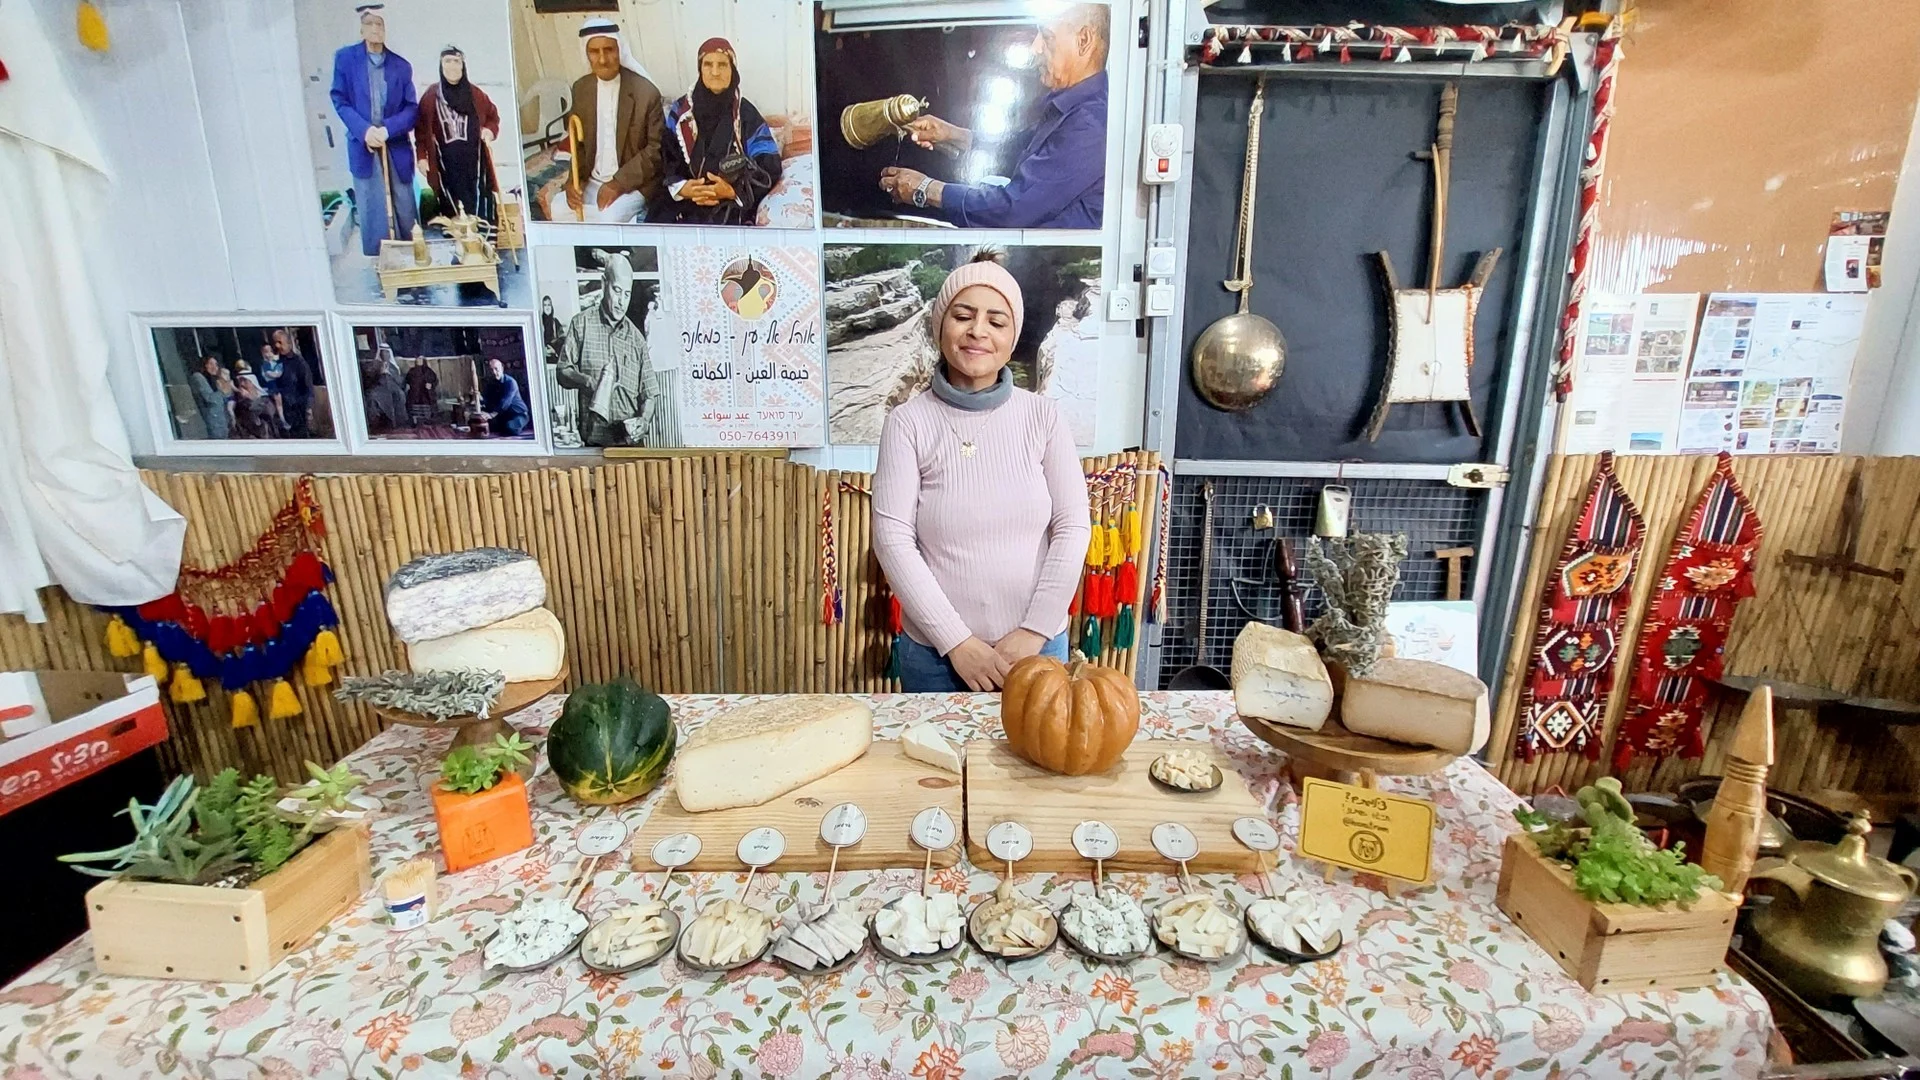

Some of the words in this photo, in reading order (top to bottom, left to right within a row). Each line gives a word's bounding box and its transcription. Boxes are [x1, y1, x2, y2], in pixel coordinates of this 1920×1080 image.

[681, 320, 721, 353] כמאנה
[766, 319, 780, 345] אל
[788, 319, 816, 345] אוהל
[692, 362, 732, 380] الكمانة
[745, 362, 776, 384] العين
[781, 363, 809, 384] خيمة
[735, 411, 750, 423] عيد
[788, 411, 804, 421] עיד
[719, 430, 798, 442] 050-7643911
